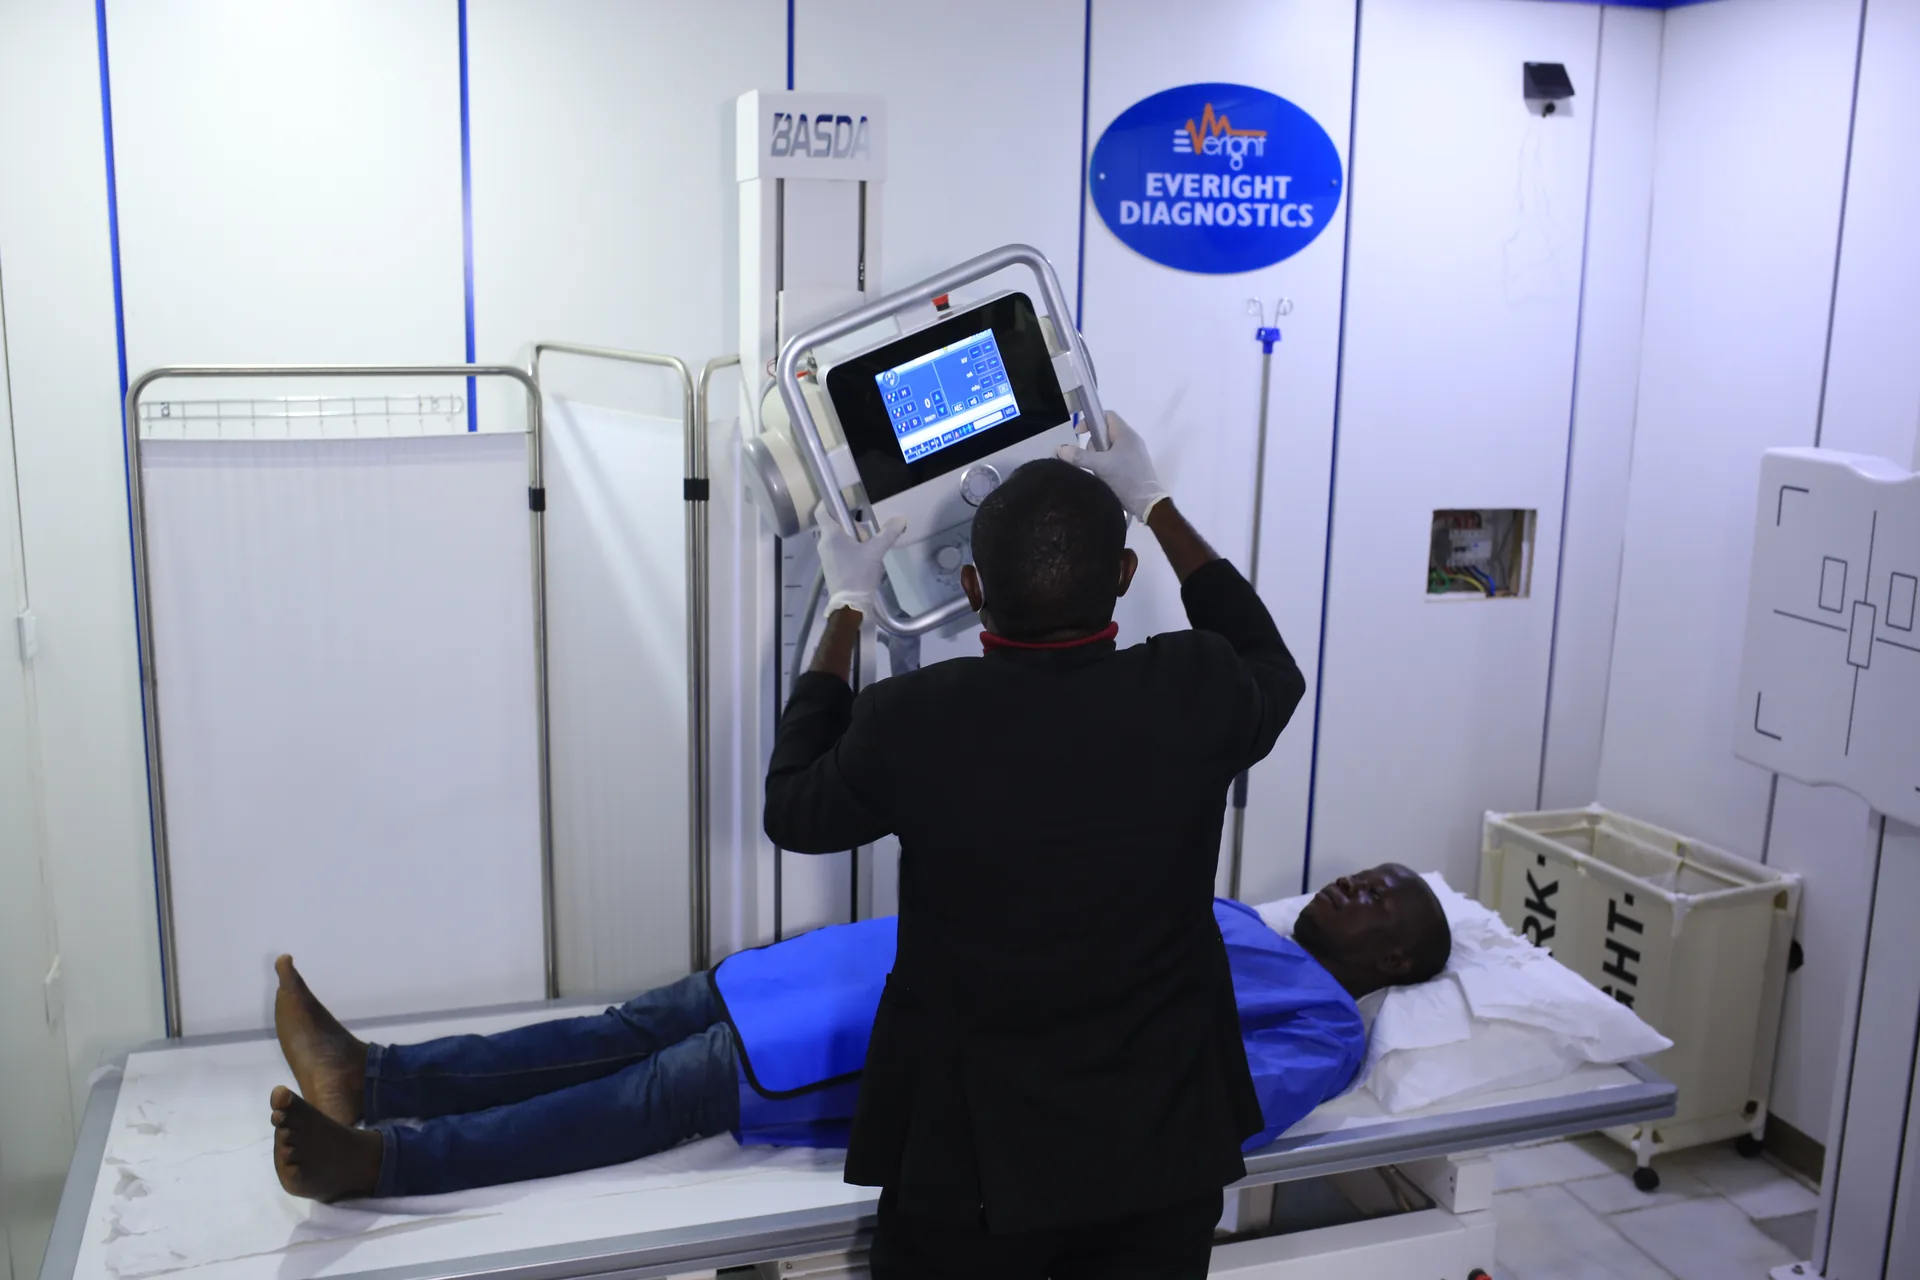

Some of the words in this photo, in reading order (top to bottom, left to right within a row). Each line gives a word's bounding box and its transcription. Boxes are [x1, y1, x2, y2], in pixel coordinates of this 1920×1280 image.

[770, 112, 870, 160] BASDA
[1145, 172, 1292, 200] EVERIGHT
[1119, 201, 1314, 228] DIAGNOSTICS
